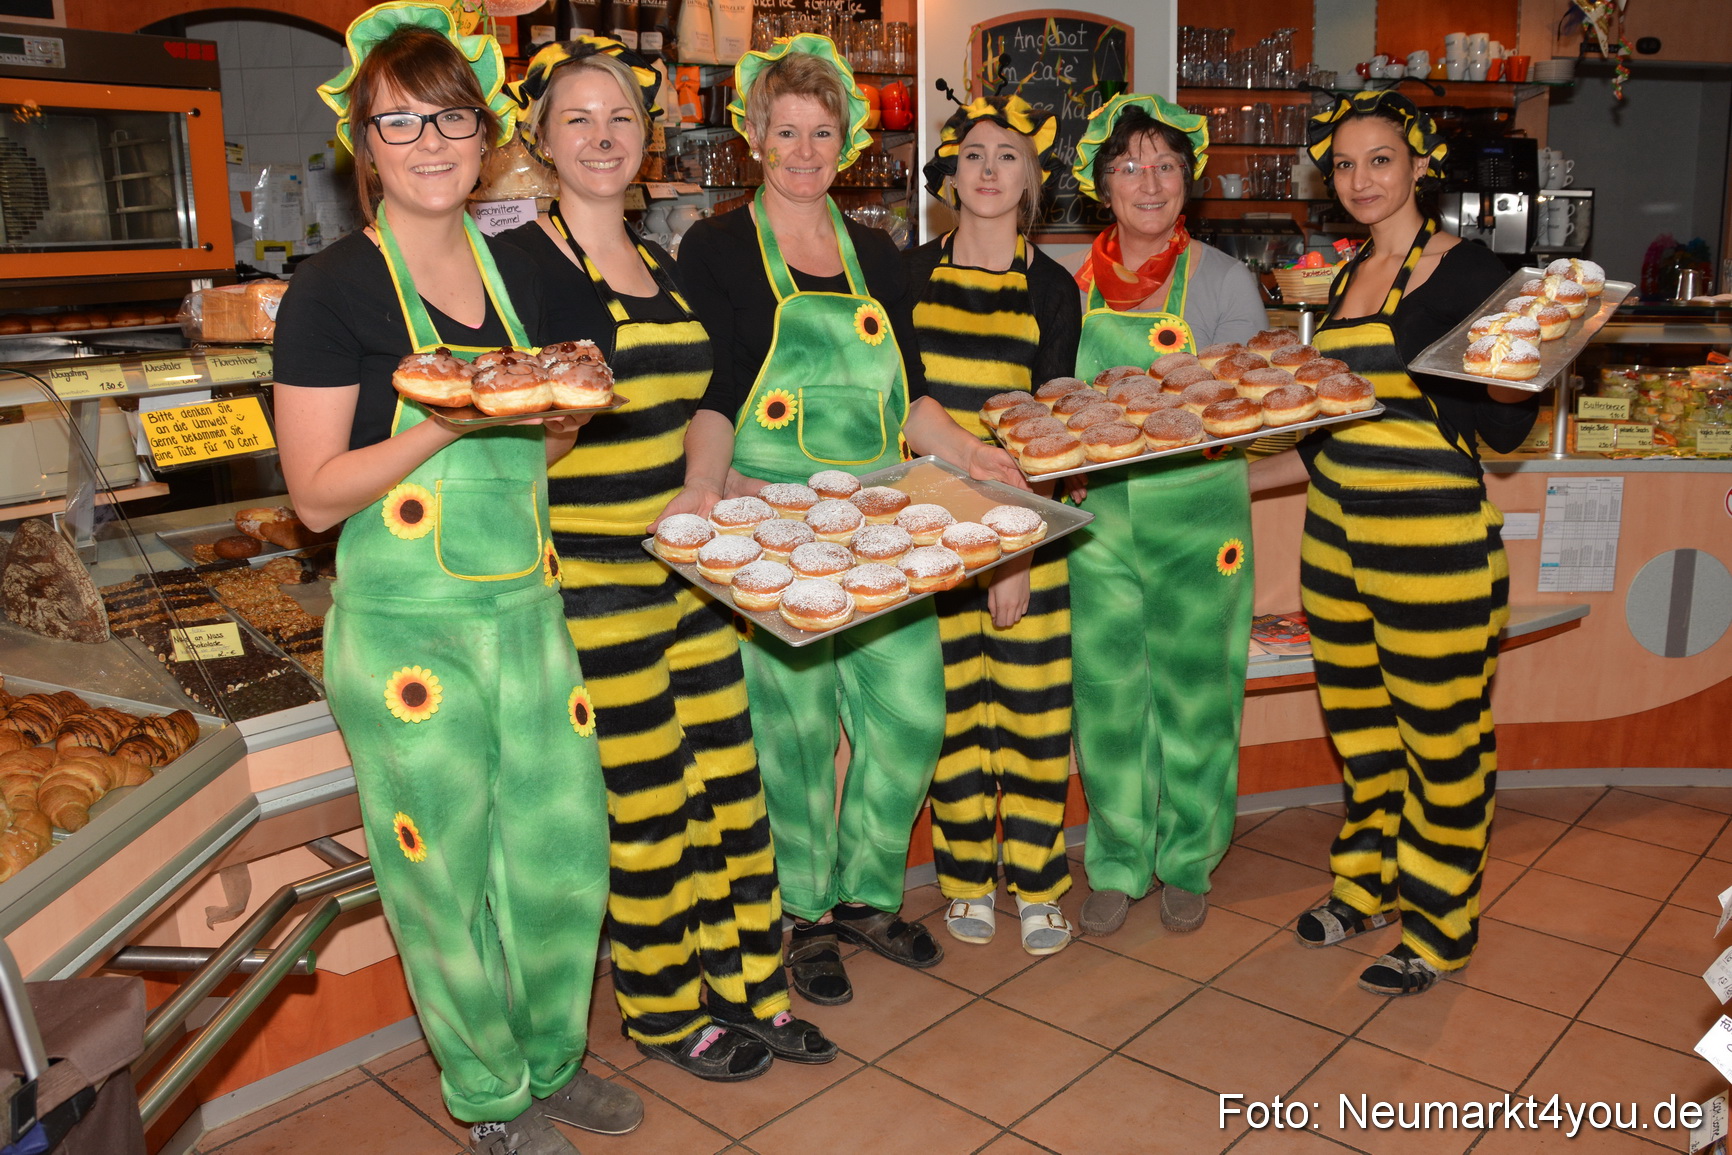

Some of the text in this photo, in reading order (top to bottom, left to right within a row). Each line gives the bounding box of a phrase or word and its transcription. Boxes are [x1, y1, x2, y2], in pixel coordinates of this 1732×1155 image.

[1014, 23, 1088, 55] Angebot
[476, 204, 522, 220] geschnittene
[490, 215, 520, 227] Semmel
[145, 362, 182, 373] Nusstaler
[212, 356, 258, 368] Florentiner
[117, 381, 125, 389] €
[147, 402, 233, 424] Bitte denken Sie
[156, 416, 228, 435] an die Umwelt
[150, 424, 244, 448] Gerne bekommen Sie
[154, 433, 259, 462] eine Tüte für 10 Cent
